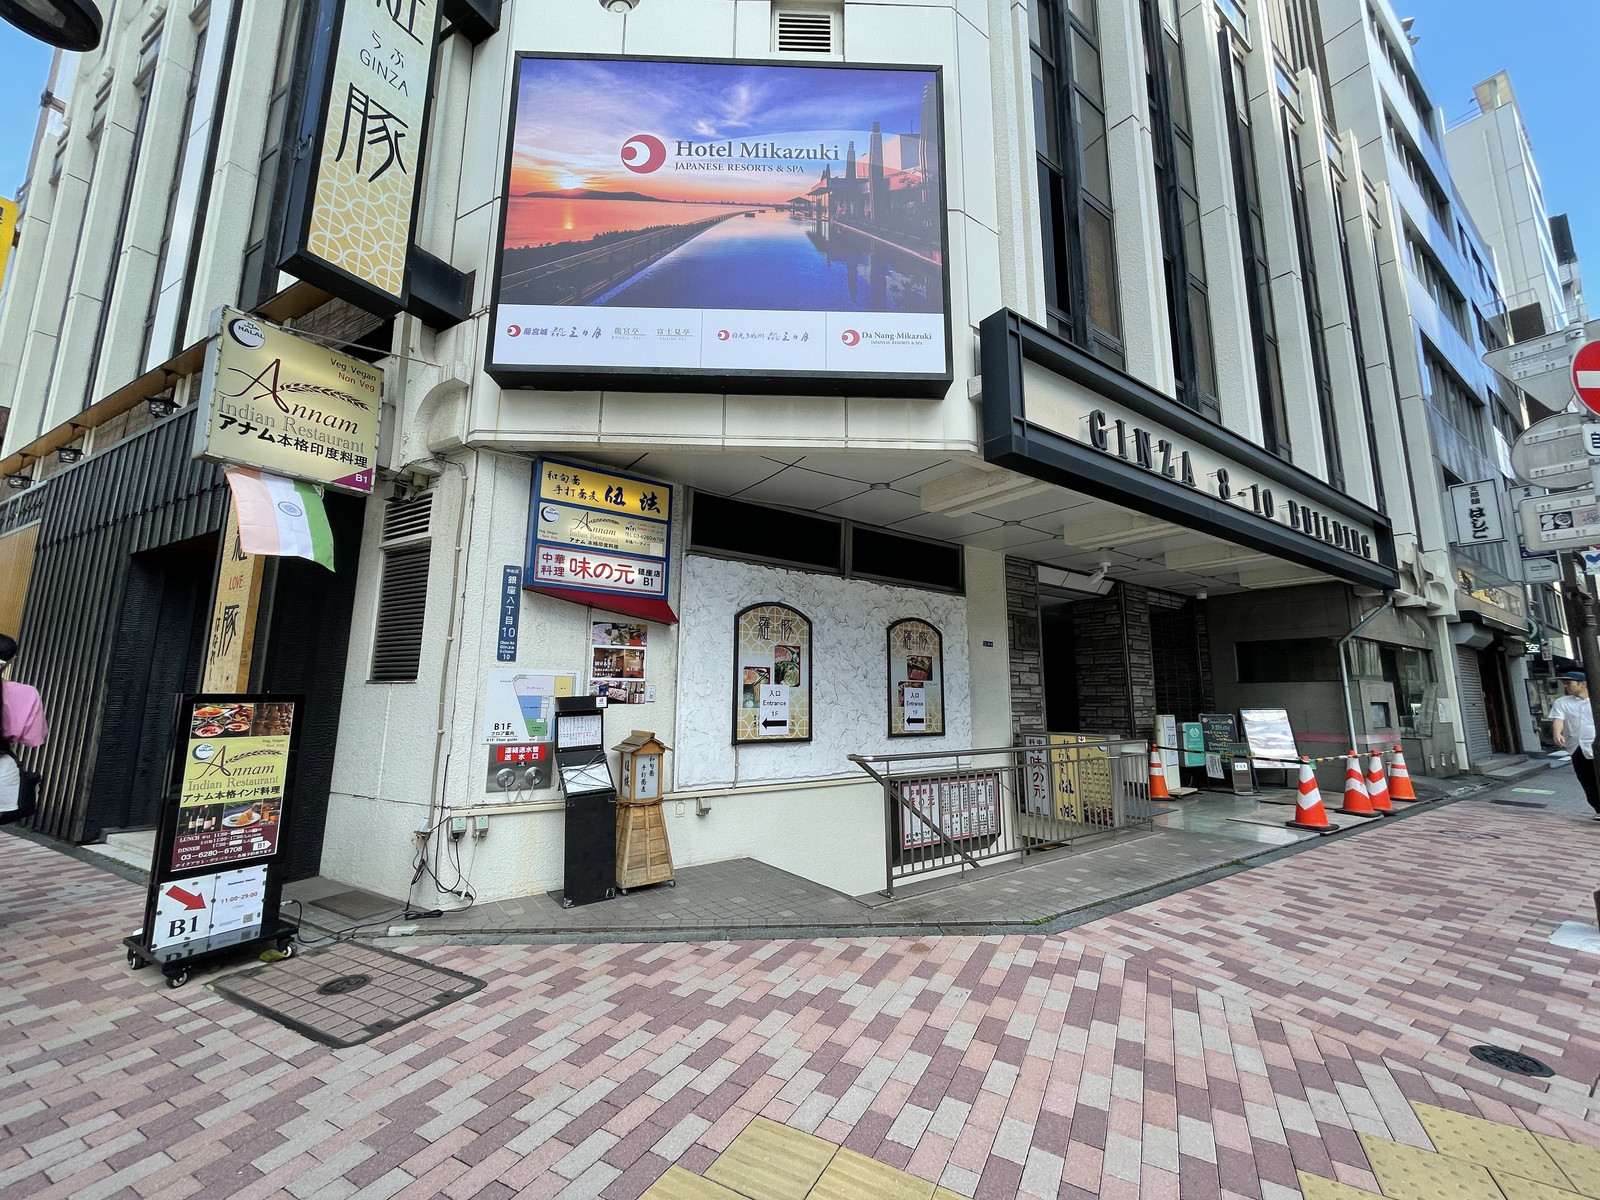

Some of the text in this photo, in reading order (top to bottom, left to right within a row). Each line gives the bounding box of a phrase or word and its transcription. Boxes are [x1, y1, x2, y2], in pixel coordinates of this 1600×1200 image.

[371, 30, 405, 69] らぶ
[359, 48, 409, 97] GINZA
[335, 82, 409, 183] 豚
[675, 140, 840, 161] Hotel Mikazuki
[674, 162, 804, 173] JAPANESE RESORTS & SPA
[238, 325, 264, 339] HALAL
[862, 331, 873, 339] Da
[350, 365, 377, 381] Vegan
[338, 372, 376, 393] Non Veg
[218, 358, 359, 434] Annam
[218, 395, 365, 453] Indian Restaurant
[218, 413, 368, 469] アナム本格印度料理
[355, 473, 369, 484] B1
[1089, 408, 1372, 559] GINZA 8-10 BUILDING
[553, 484, 599, 503] 手打蕎麦
[572, 511, 617, 536] Annam
[569, 529, 619, 543] Indian Restaurant
[542, 551, 566, 565] 中華
[540, 564, 565, 578] 料理
[569, 556, 635, 585] 味の元
[637, 567, 661, 578] 銀座店
[228, 574, 244, 591] LOVE
[643, 577, 654, 587] B1
[501, 575, 517, 638] 銀座八丁目 10
[494, 722, 512, 731] B1F
[504, 746, 539, 754] 連結送水管
[188, 745, 275, 780] Annam
[188, 776, 279, 791] Indian Restaurant
[183, 785, 281, 804] アナム本格インド料理
[179, 835, 200, 843] LUNCH
[177, 845, 201, 853] DINNER
[167, 915, 198, 938] B1
